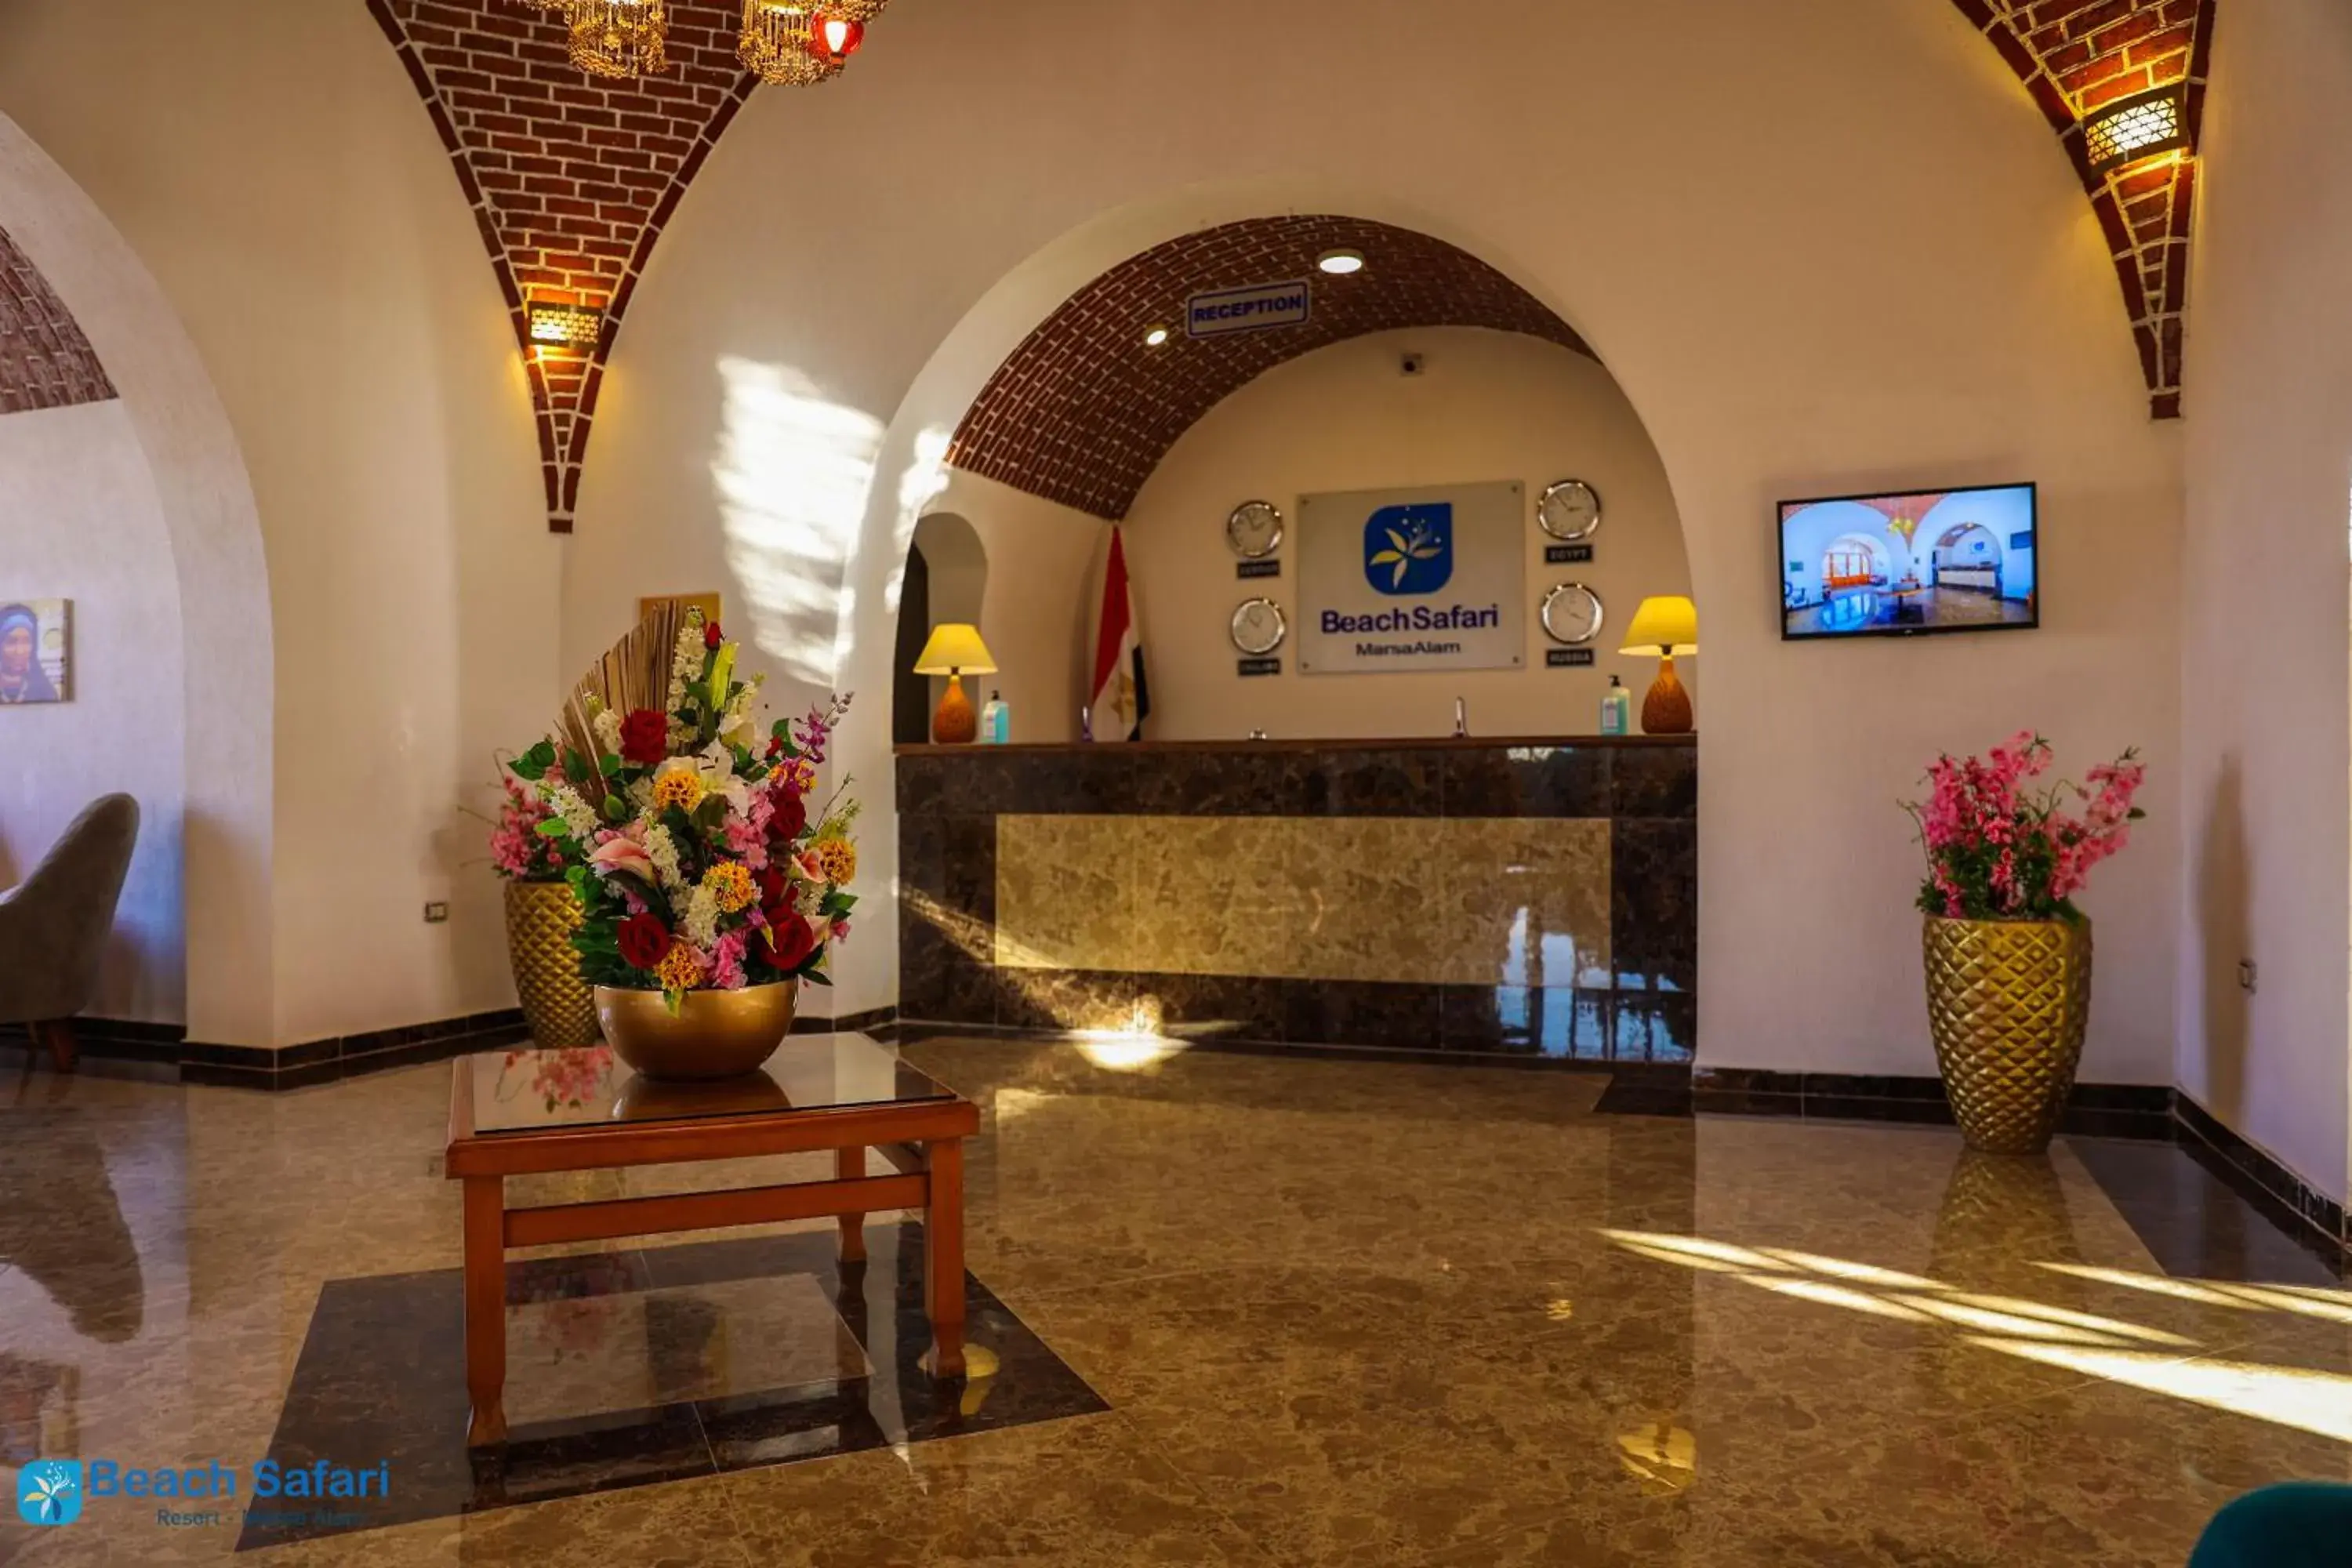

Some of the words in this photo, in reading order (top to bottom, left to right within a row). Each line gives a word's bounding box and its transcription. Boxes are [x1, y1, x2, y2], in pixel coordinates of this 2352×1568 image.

[1193, 294, 1301, 322] RECEPTION
[1321, 603, 1498, 633] BeachSafari
[1356, 641, 1461, 656] MarsaAlam
